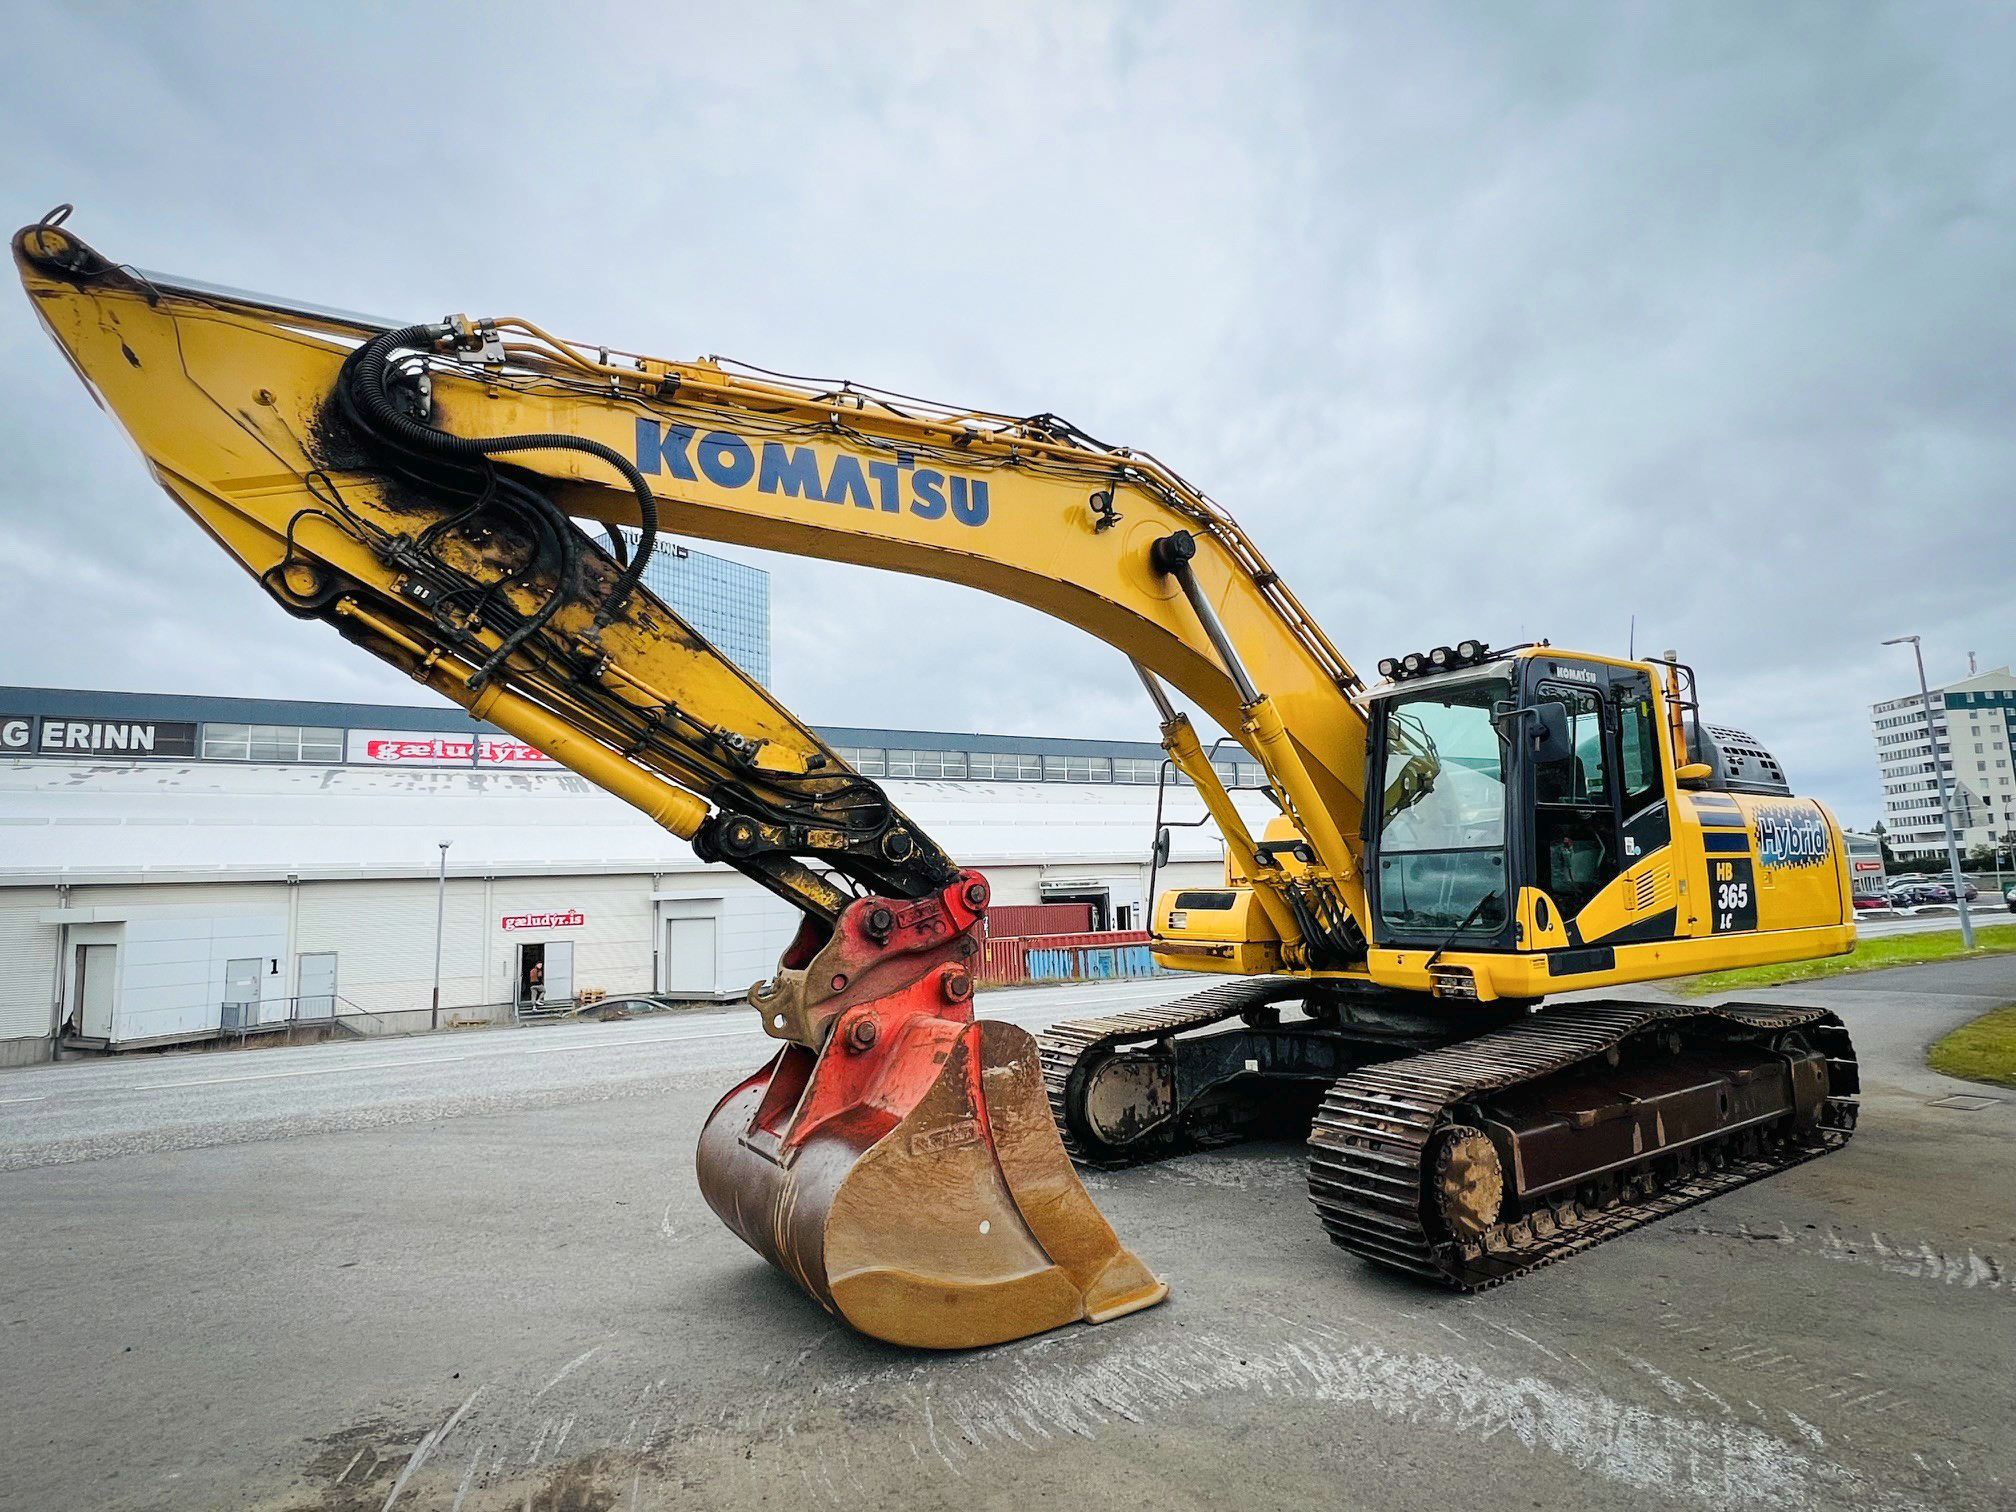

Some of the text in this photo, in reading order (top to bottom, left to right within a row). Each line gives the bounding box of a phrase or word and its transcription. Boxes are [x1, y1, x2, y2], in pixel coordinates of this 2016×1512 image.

[635, 417, 990, 527] KOMATSU
[1556, 666, 1597, 684] KOMATSU
[1758, 815, 1826, 860] Hybrid
[1716, 862, 1734, 881] HB
[1718, 883, 1748, 910] 365
[505, 910, 582, 931] gæludýr.is
[1720, 912, 1733, 930] LC
[270, 958, 279, 975] 1
